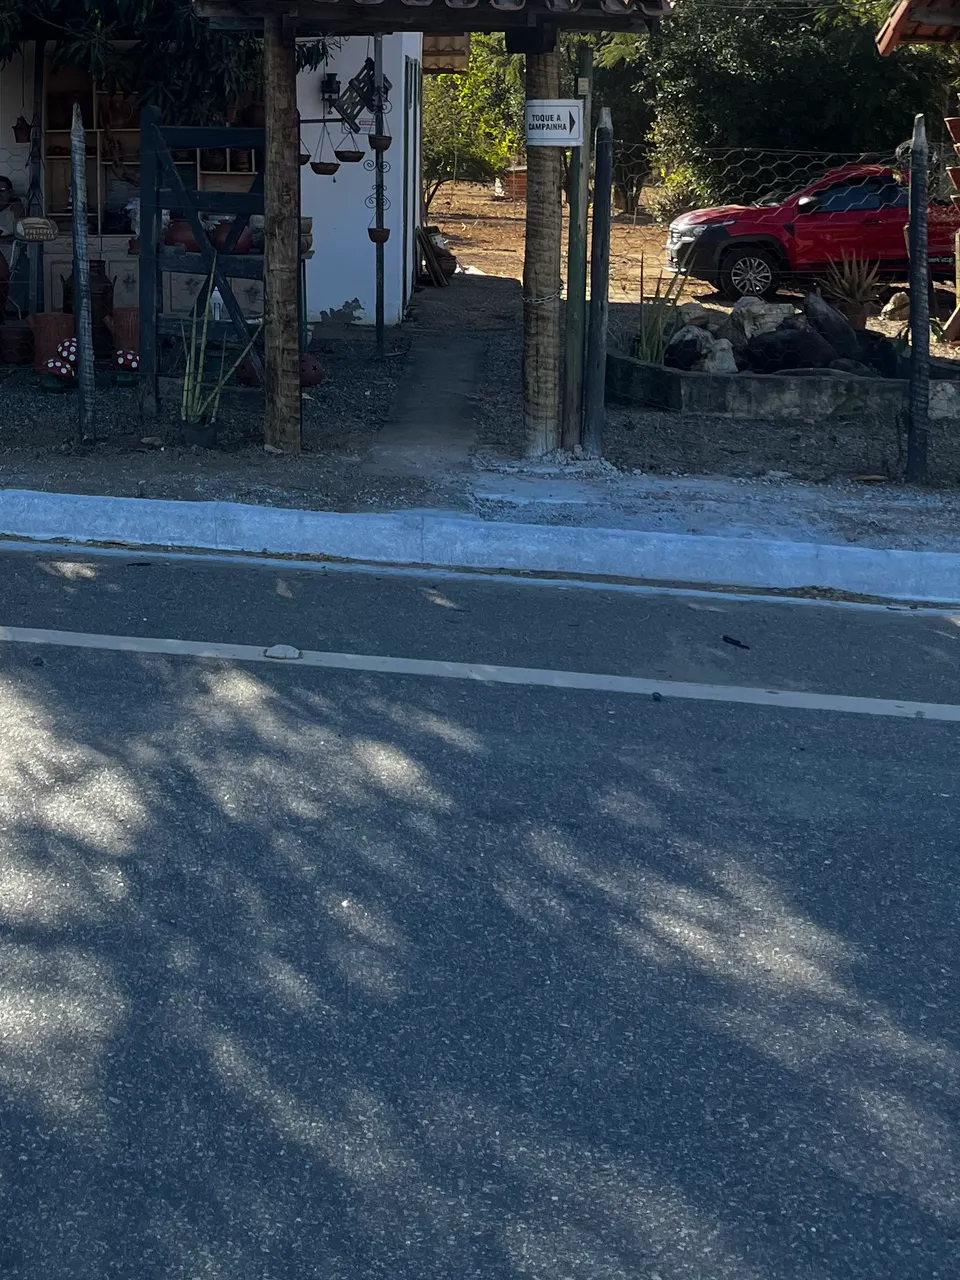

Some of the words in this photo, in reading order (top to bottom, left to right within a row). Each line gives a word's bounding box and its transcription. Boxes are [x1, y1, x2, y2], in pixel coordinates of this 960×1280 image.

[532, 114, 554, 122] TOQUE
[556, 114, 561, 122] A
[528, 123, 567, 131] CAMPAINHA
